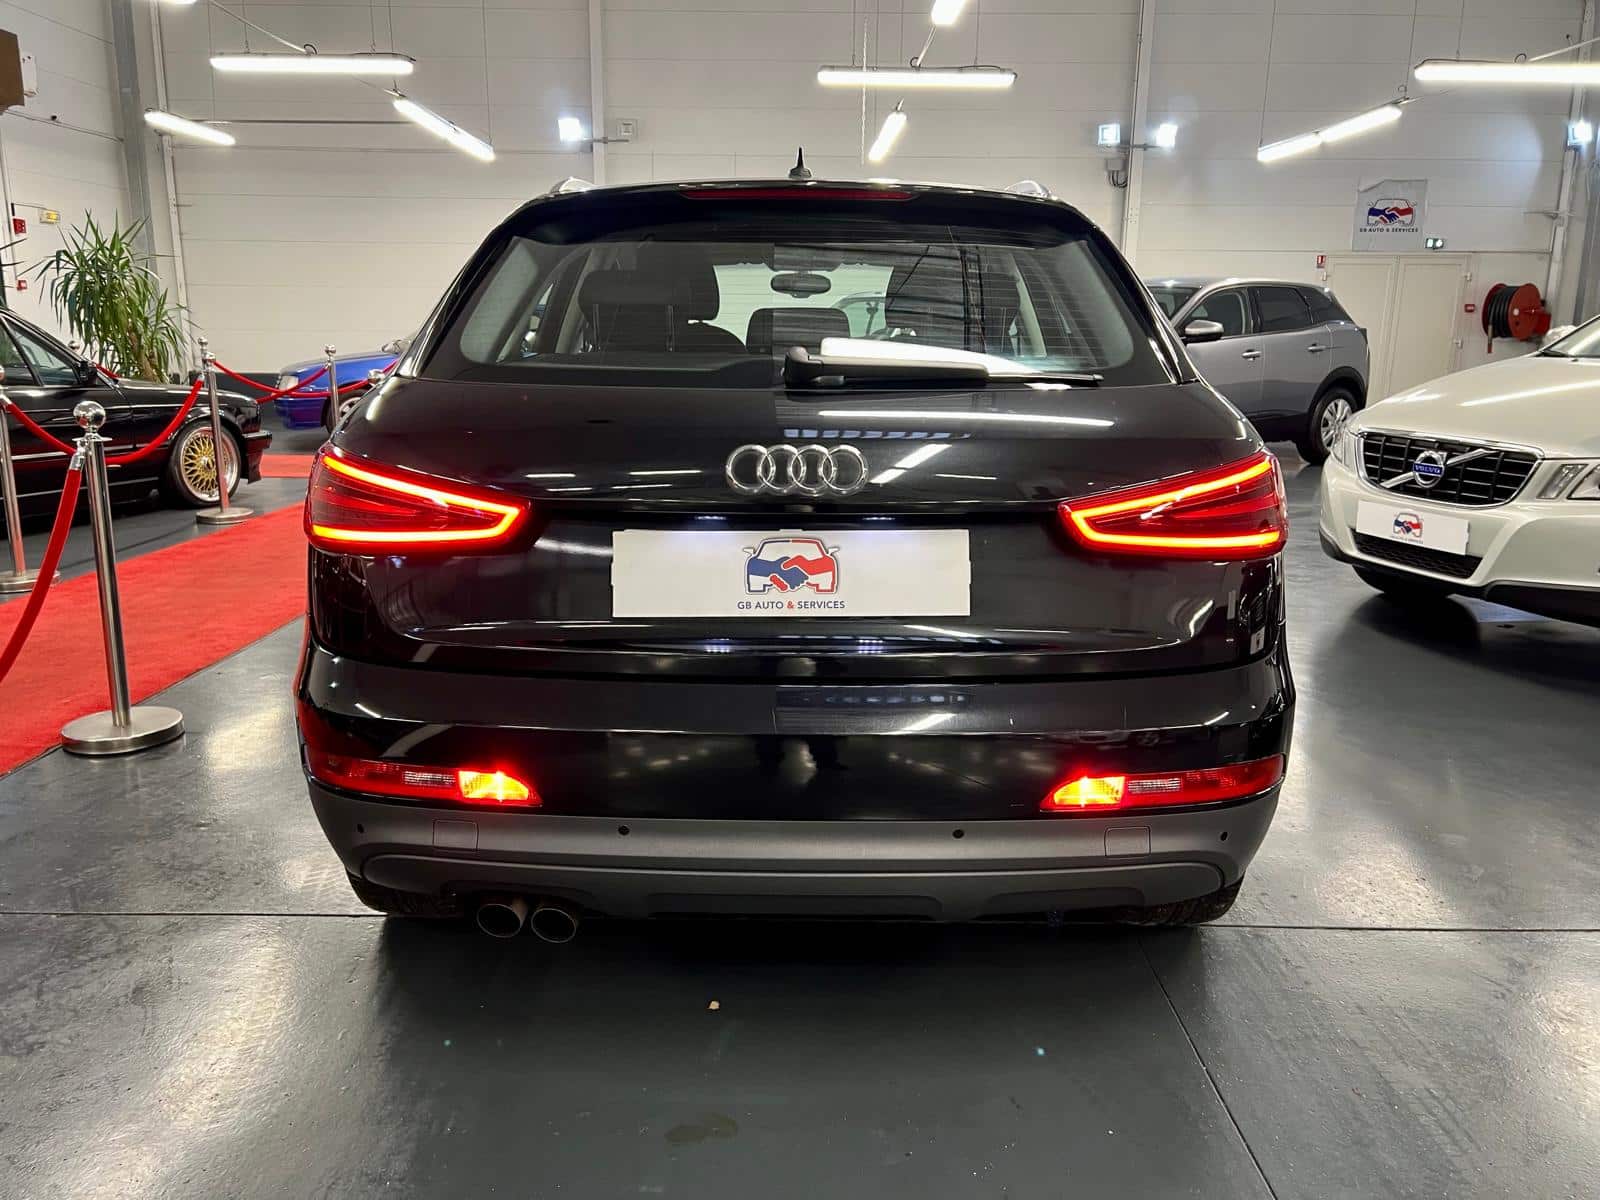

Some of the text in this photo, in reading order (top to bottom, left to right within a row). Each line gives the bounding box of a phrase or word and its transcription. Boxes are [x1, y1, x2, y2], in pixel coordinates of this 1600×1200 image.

[1415, 464, 1441, 474] VOLVO
[737, 600, 846, 610] GB AUTO & SERVICES
